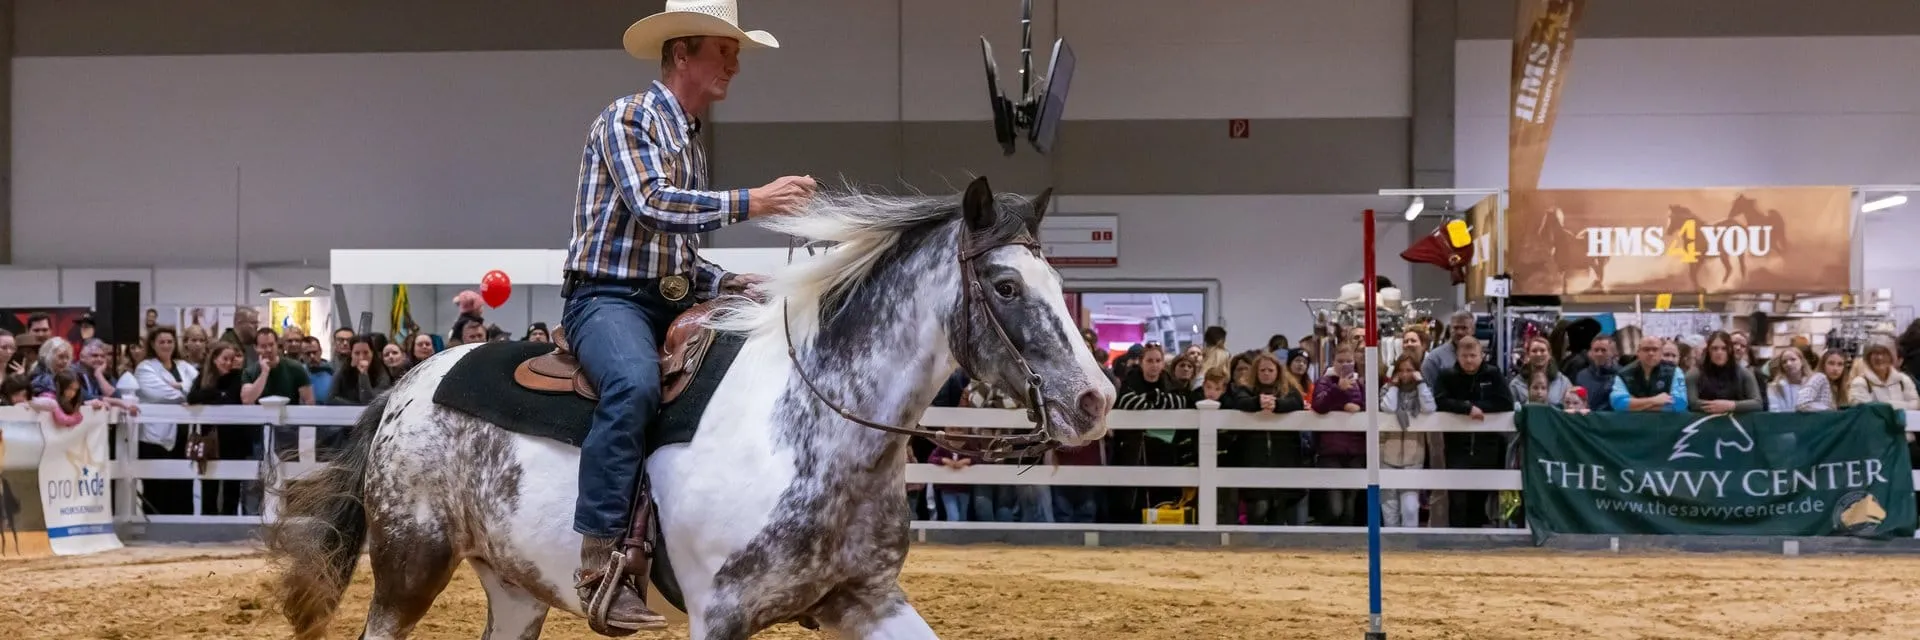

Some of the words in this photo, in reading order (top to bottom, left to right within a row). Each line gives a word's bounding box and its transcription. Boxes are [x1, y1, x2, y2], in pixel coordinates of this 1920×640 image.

[1515, 42, 1549, 121] HMS
[1587, 226, 1665, 257] HMS
[1667, 219, 1700, 263] 4
[1701, 225, 1772, 257] YOU
[47, 479, 72, 505] pro
[78, 469, 104, 497] ride
[1538, 458, 1607, 492] THE
[1619, 469, 1732, 498] SAVVY
[1742, 458, 1888, 497] CENTER
[1595, 496, 1824, 520] www.thesavvycenter.de
